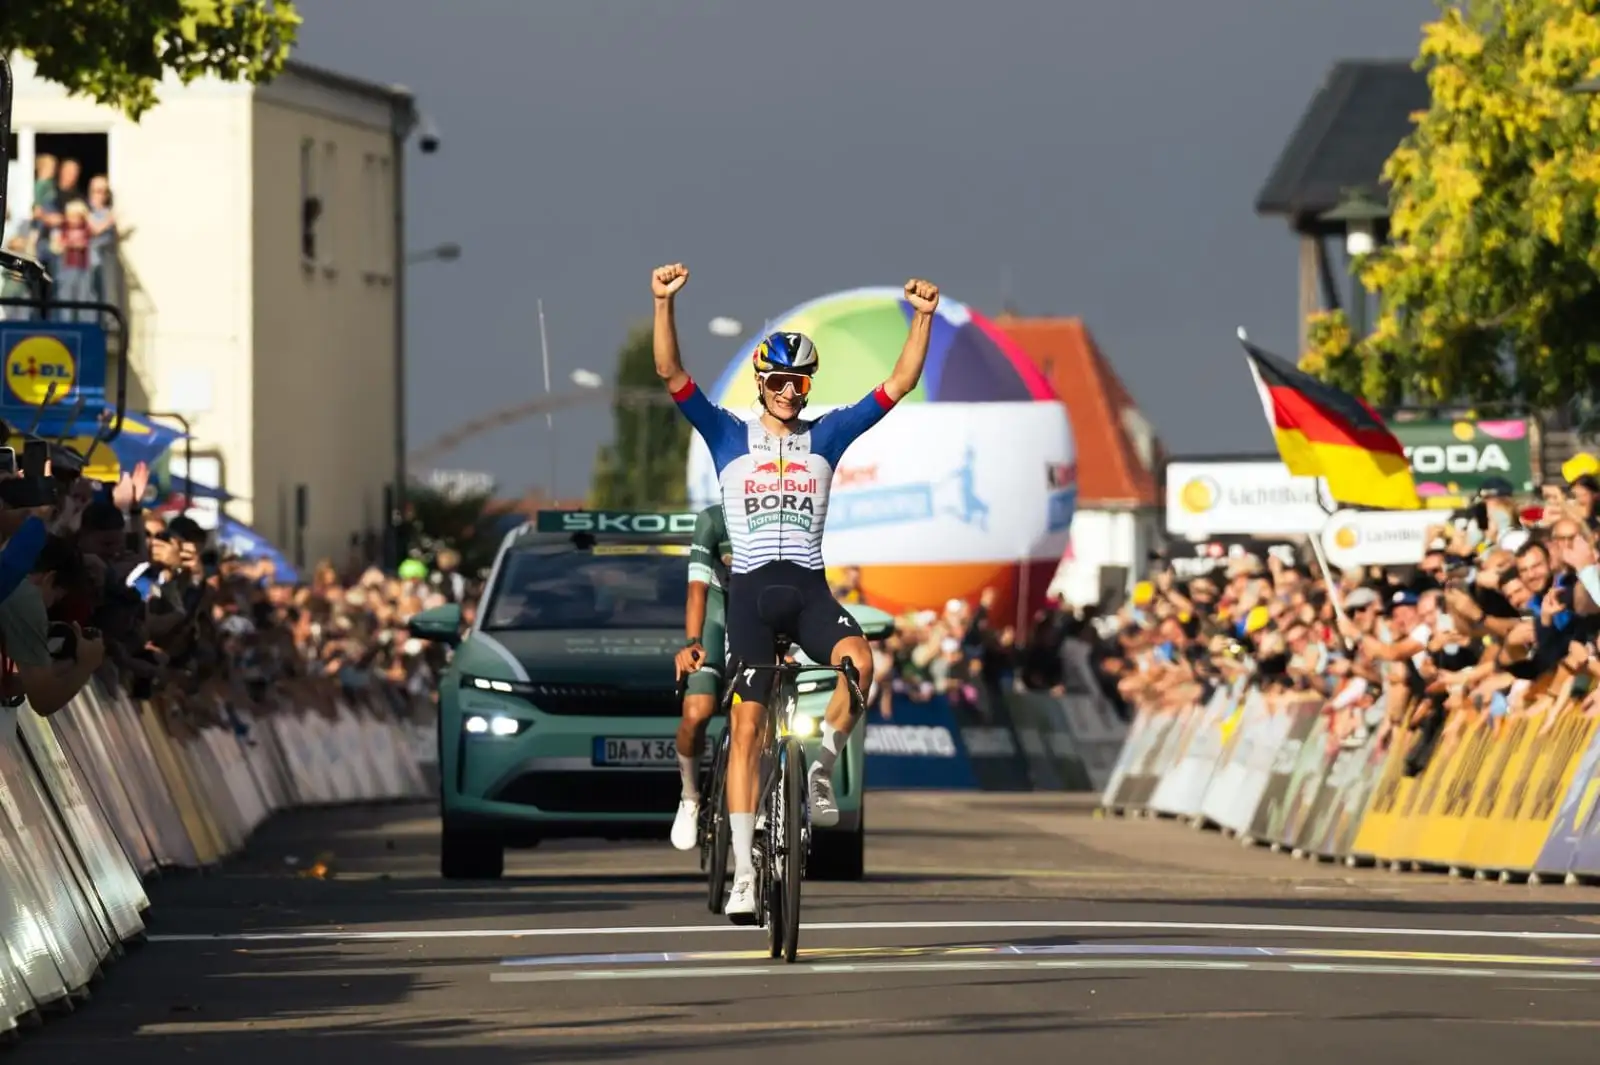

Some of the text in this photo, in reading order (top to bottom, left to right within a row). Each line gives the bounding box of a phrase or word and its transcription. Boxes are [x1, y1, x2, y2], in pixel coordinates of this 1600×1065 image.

[1404, 444, 1511, 473] ODA
[745, 479, 816, 494] Red Bull
[744, 495, 814, 516] BORA
